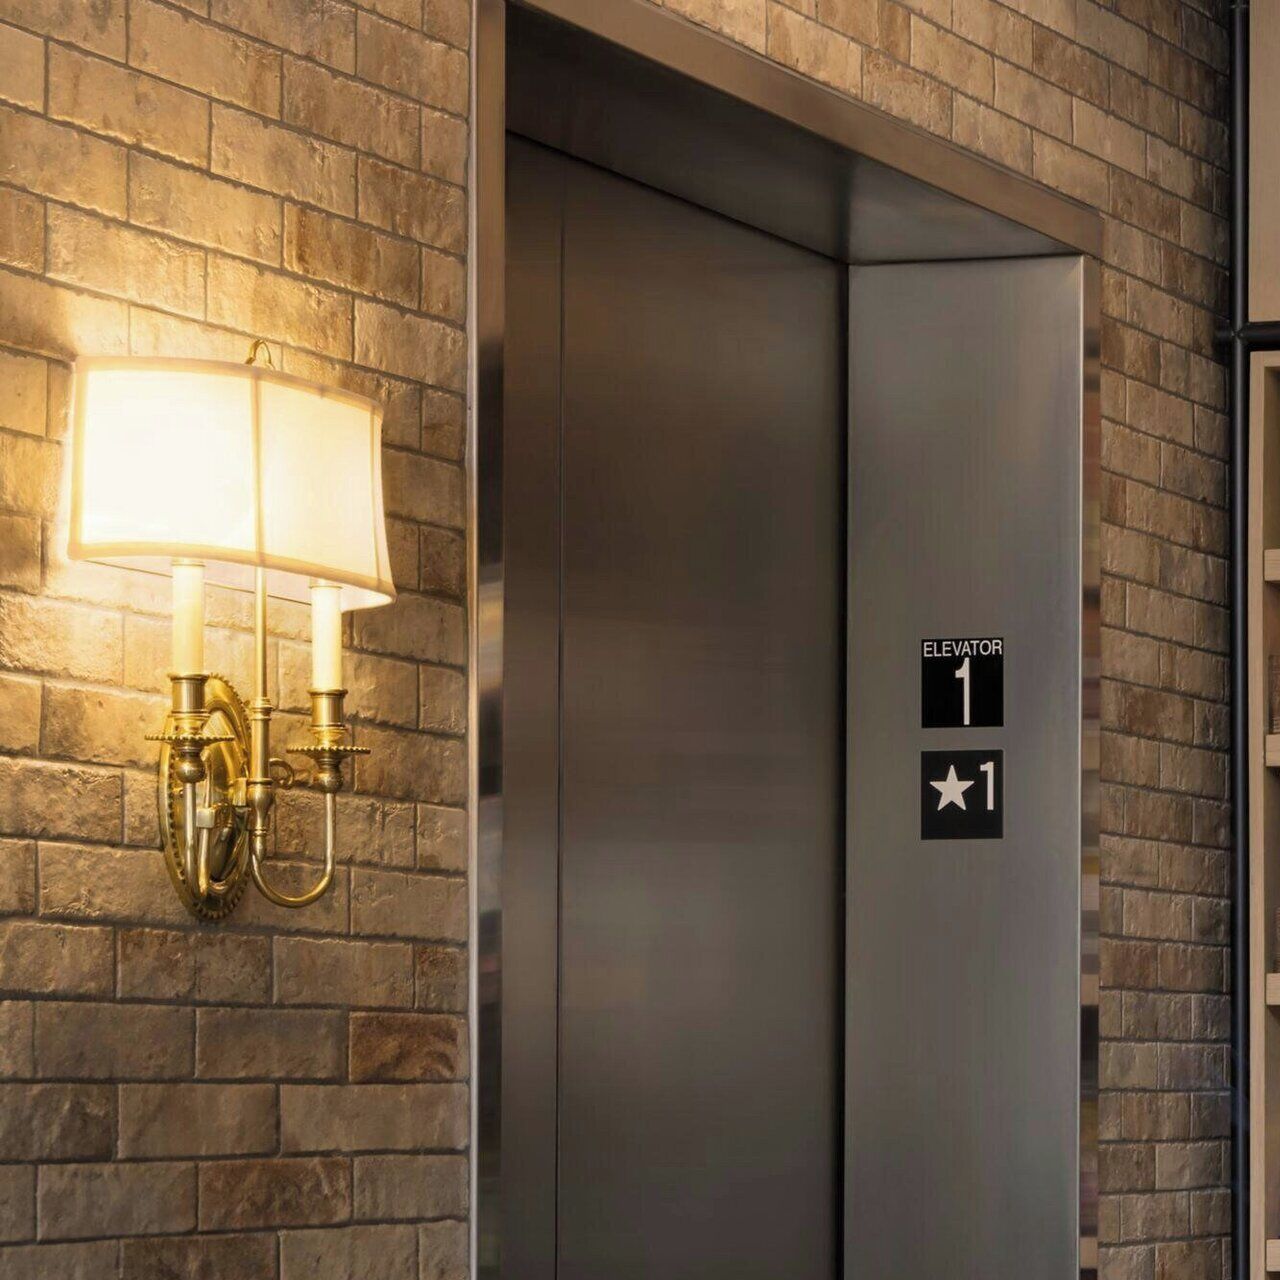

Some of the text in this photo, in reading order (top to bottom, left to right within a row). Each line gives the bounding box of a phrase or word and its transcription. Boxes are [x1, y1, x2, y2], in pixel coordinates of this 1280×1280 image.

[923, 640, 1003, 657] ELEVATOR
[955, 657, 970, 725] 1
[980, 761, 994, 810] 1
